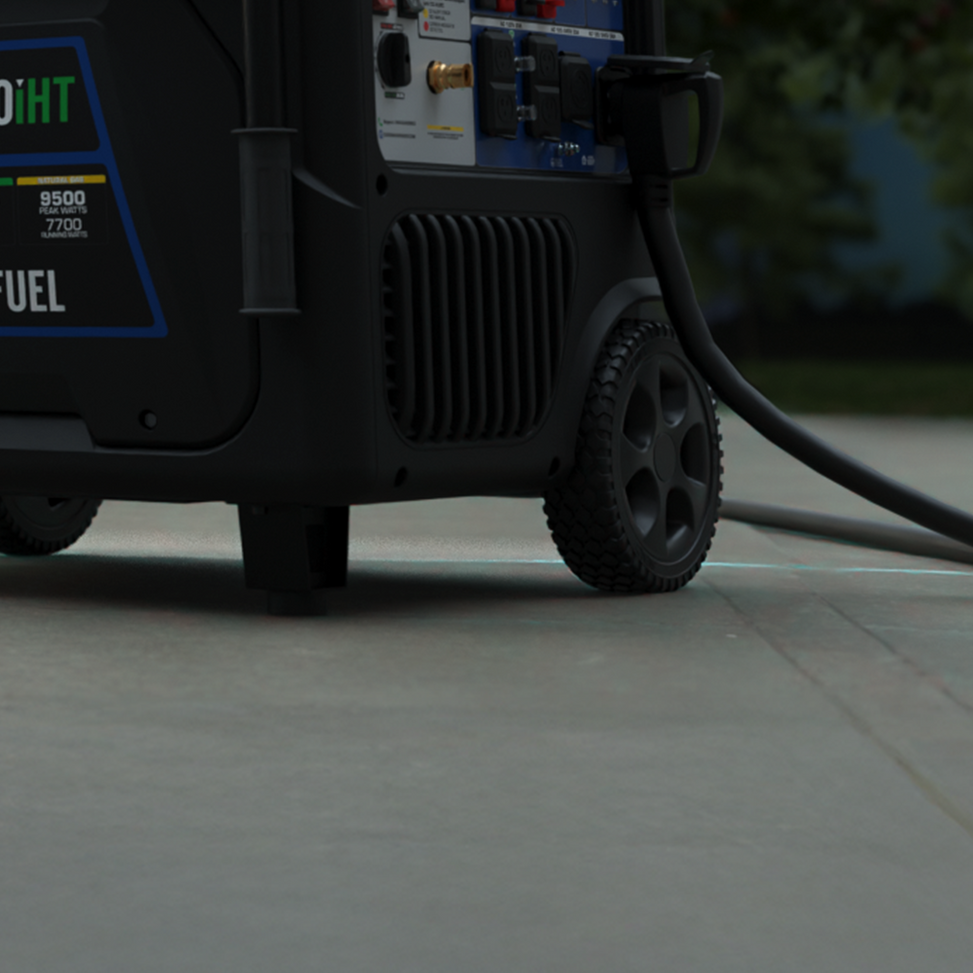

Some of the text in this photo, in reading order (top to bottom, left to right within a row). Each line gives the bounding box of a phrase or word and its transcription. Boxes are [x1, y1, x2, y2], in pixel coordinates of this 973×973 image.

[40, 190, 86, 207] 9500
[39, 206, 88, 215] PEAK WATTS
[46, 218, 83, 232] 7700
[40, 230, 88, 239] RUNNING WATTS
